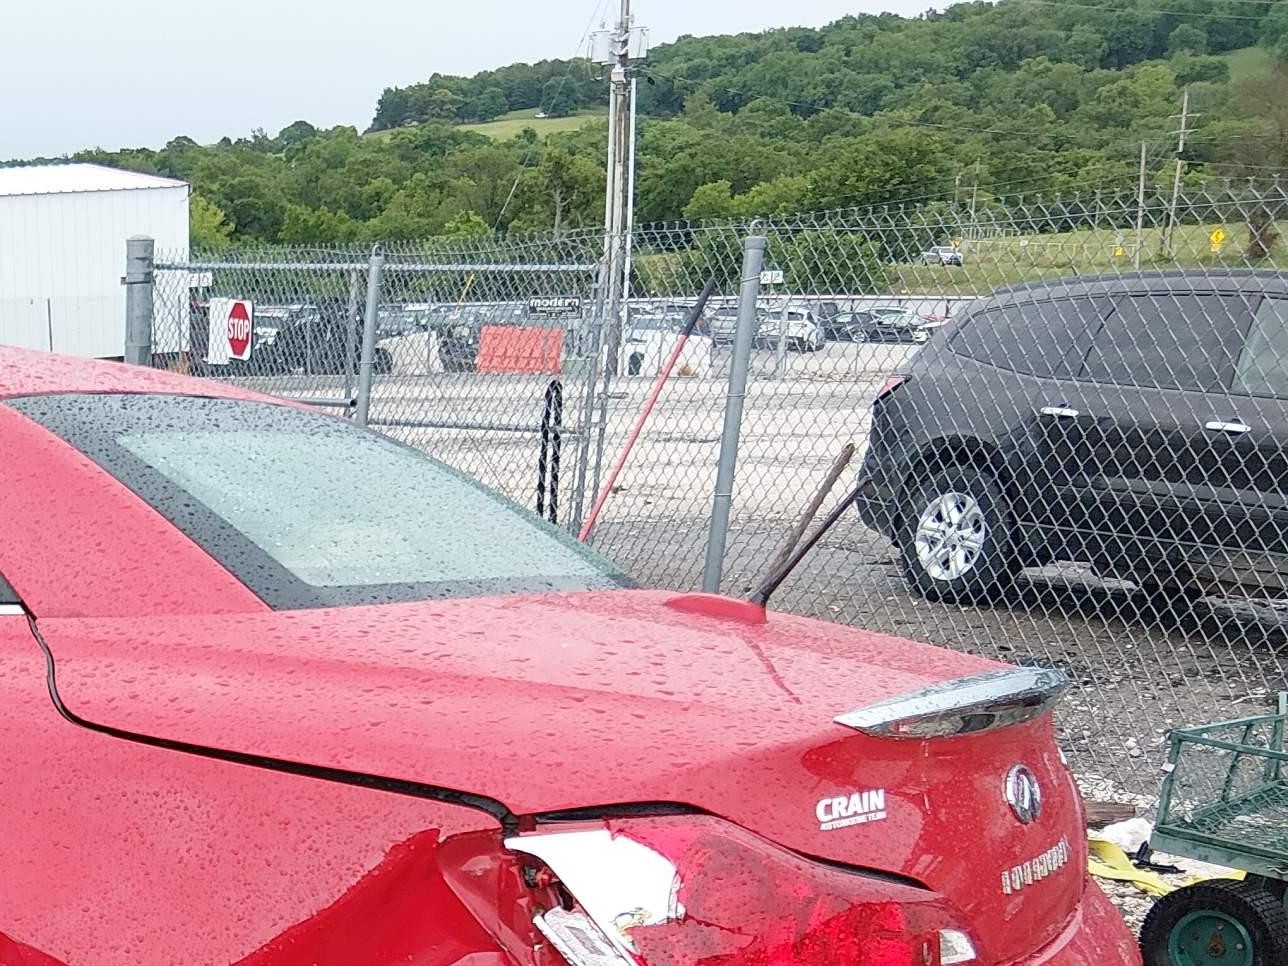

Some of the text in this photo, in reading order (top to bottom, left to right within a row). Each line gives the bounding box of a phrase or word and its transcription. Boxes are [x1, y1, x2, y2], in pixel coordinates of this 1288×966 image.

[530, 298, 580, 307] modern
[228, 318, 250, 341] STOP
[815, 788, 886, 822] CRAIN
